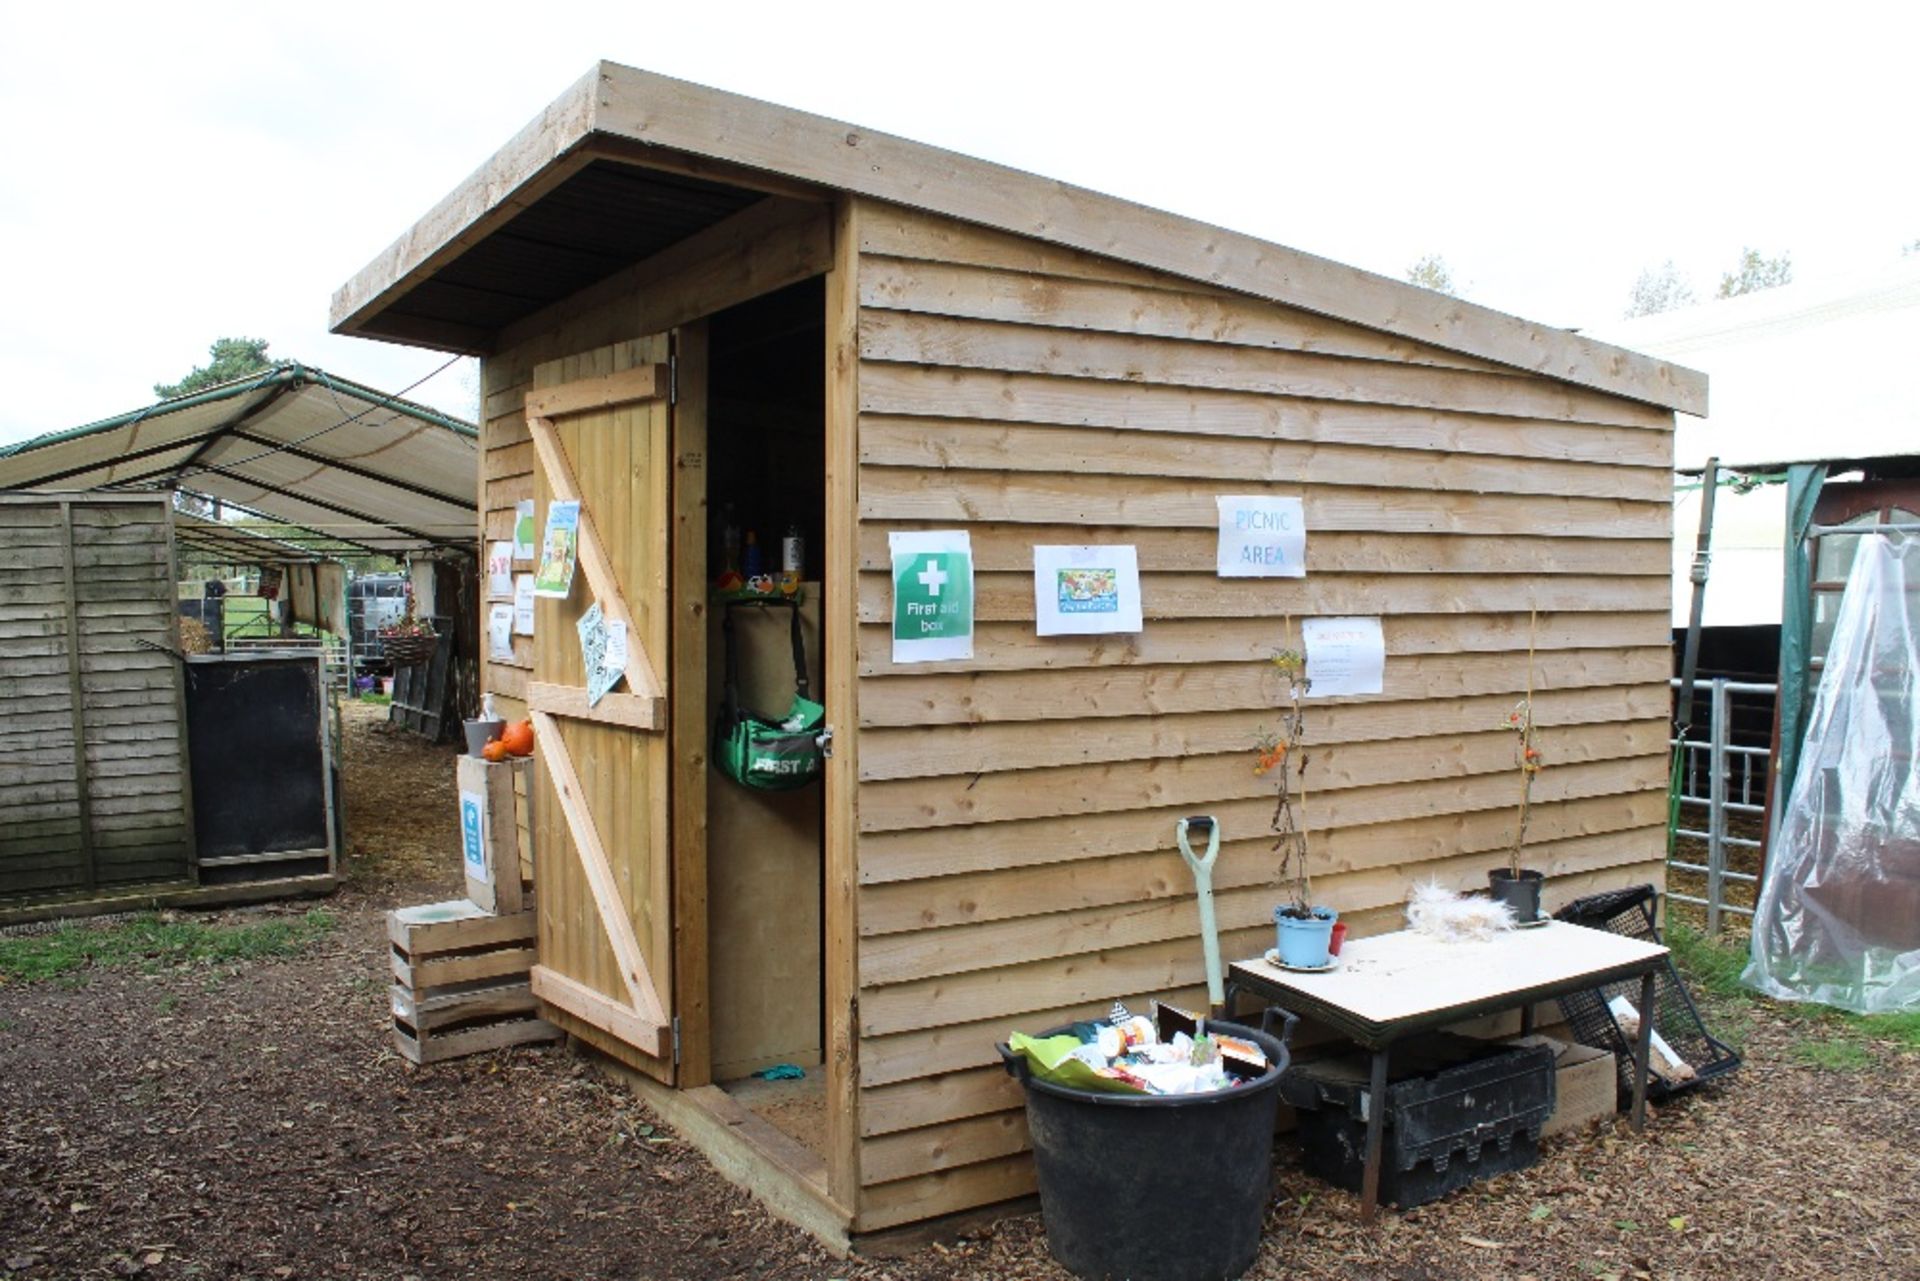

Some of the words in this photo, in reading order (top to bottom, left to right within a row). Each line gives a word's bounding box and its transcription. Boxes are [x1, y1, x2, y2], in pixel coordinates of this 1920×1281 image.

[1236, 510, 1290, 530] PICNIC
[1240, 545, 1286, 565] AREA
[907, 602, 936, 615] First
[940, 601, 959, 614] aid
[921, 620, 944, 632] box
[753, 758, 801, 774] FIRST
